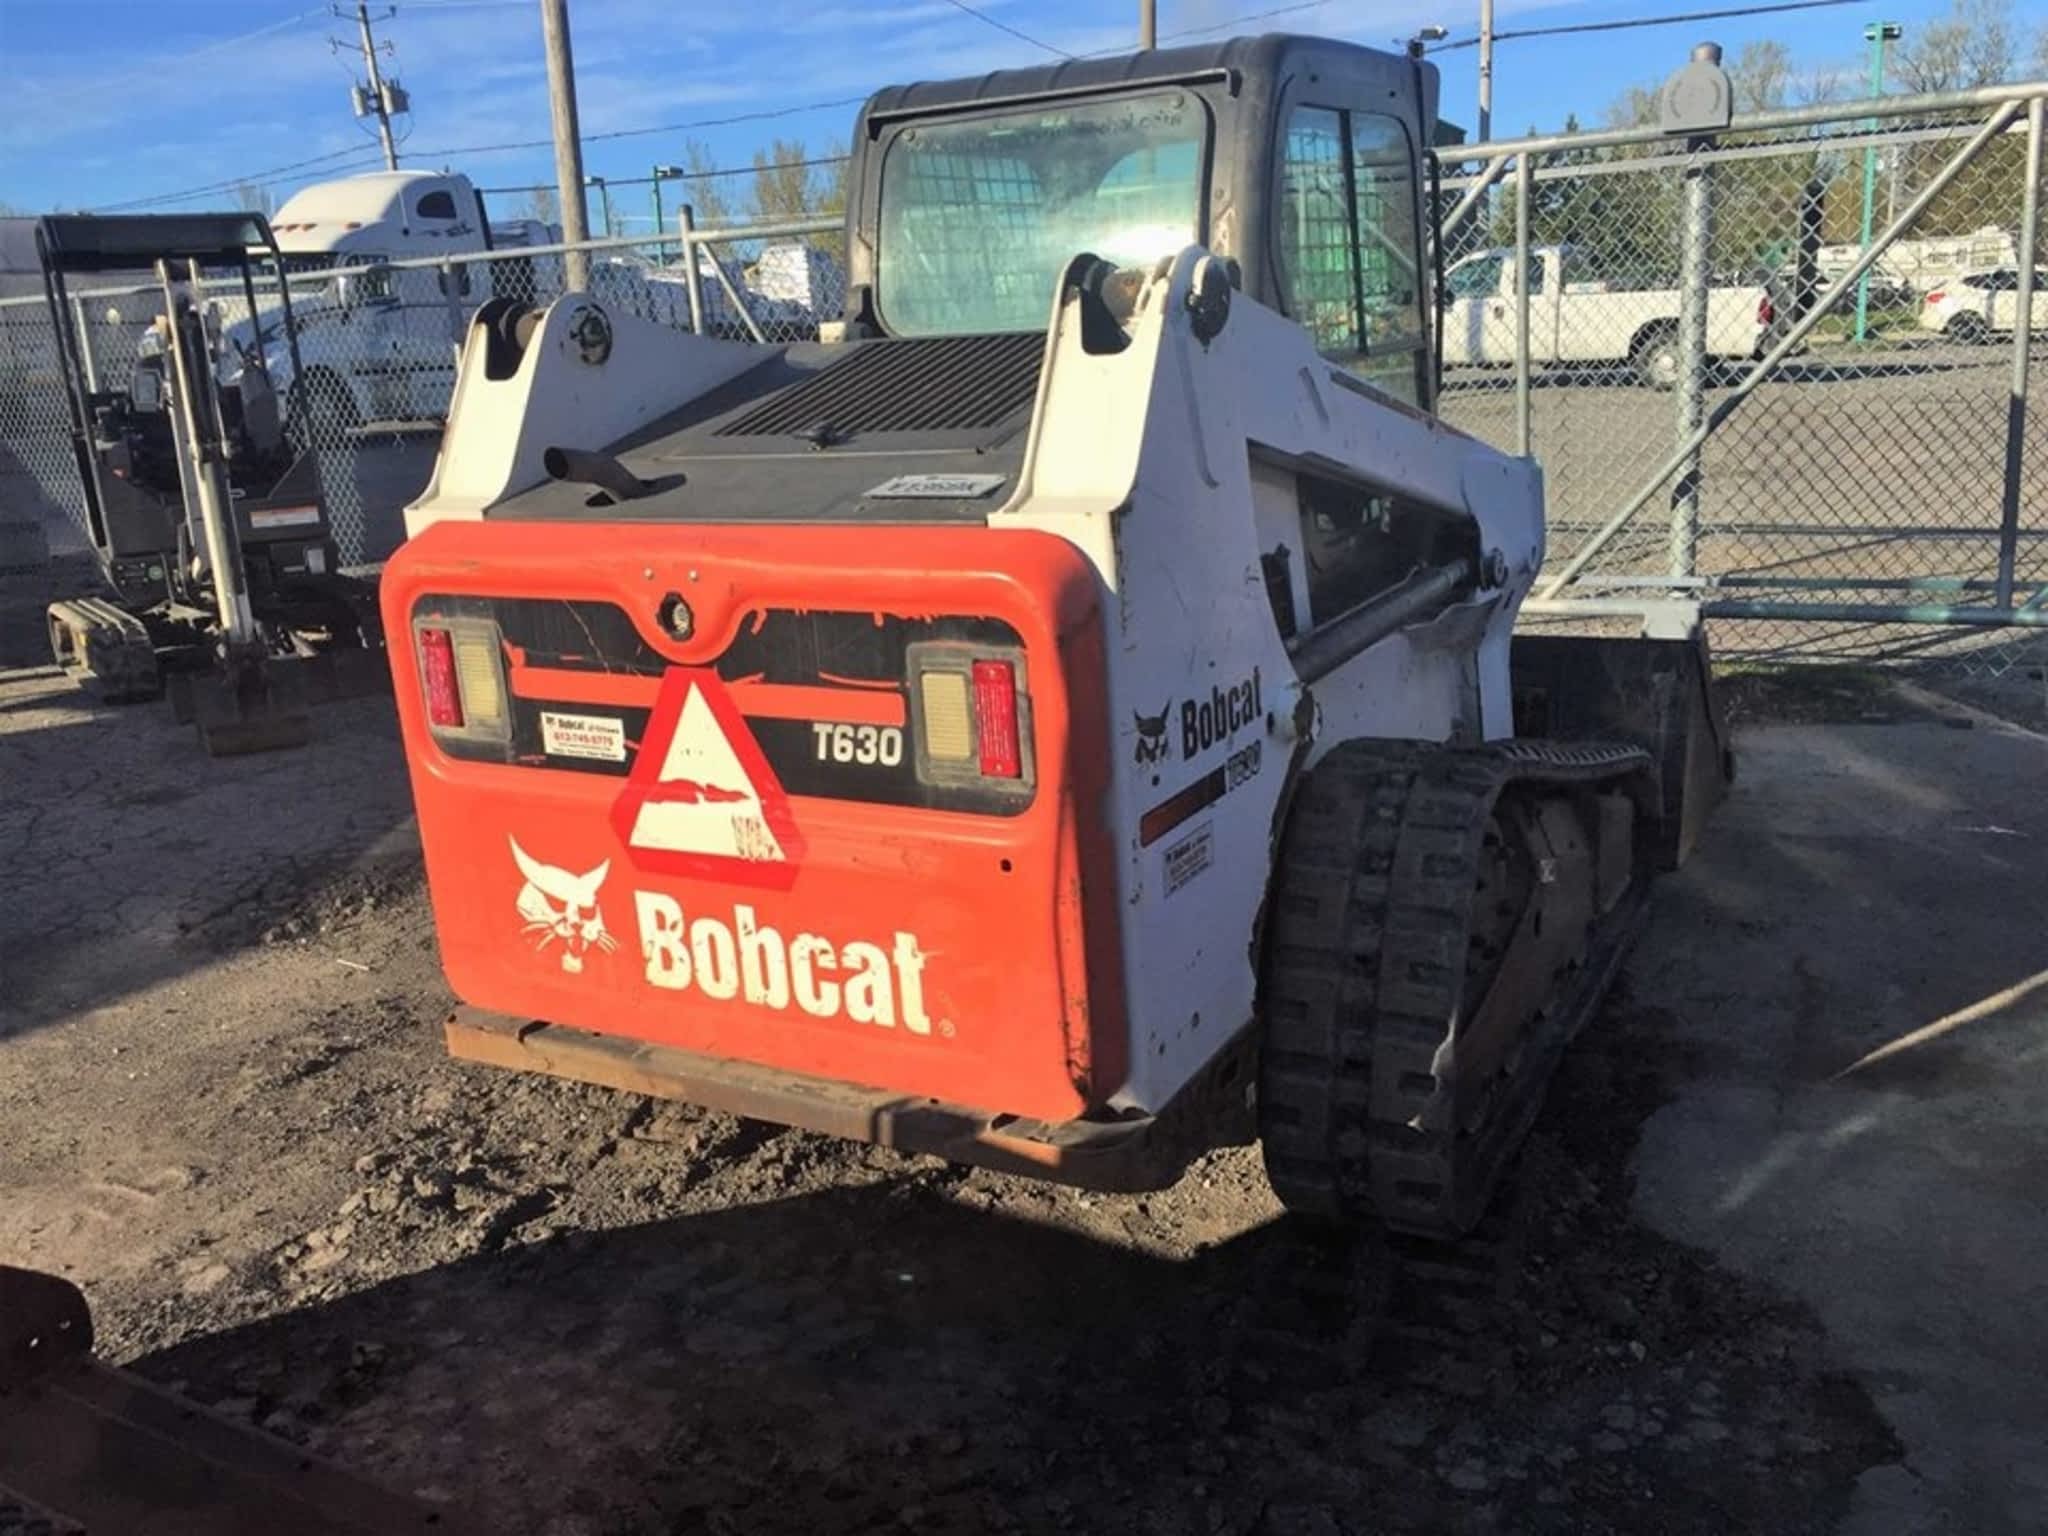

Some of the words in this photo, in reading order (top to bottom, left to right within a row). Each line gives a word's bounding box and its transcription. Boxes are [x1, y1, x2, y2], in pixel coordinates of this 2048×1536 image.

[813, 723, 902, 766] T630
[1182, 665, 1261, 761] Bobcat
[634, 889, 931, 1035] Bobcat
